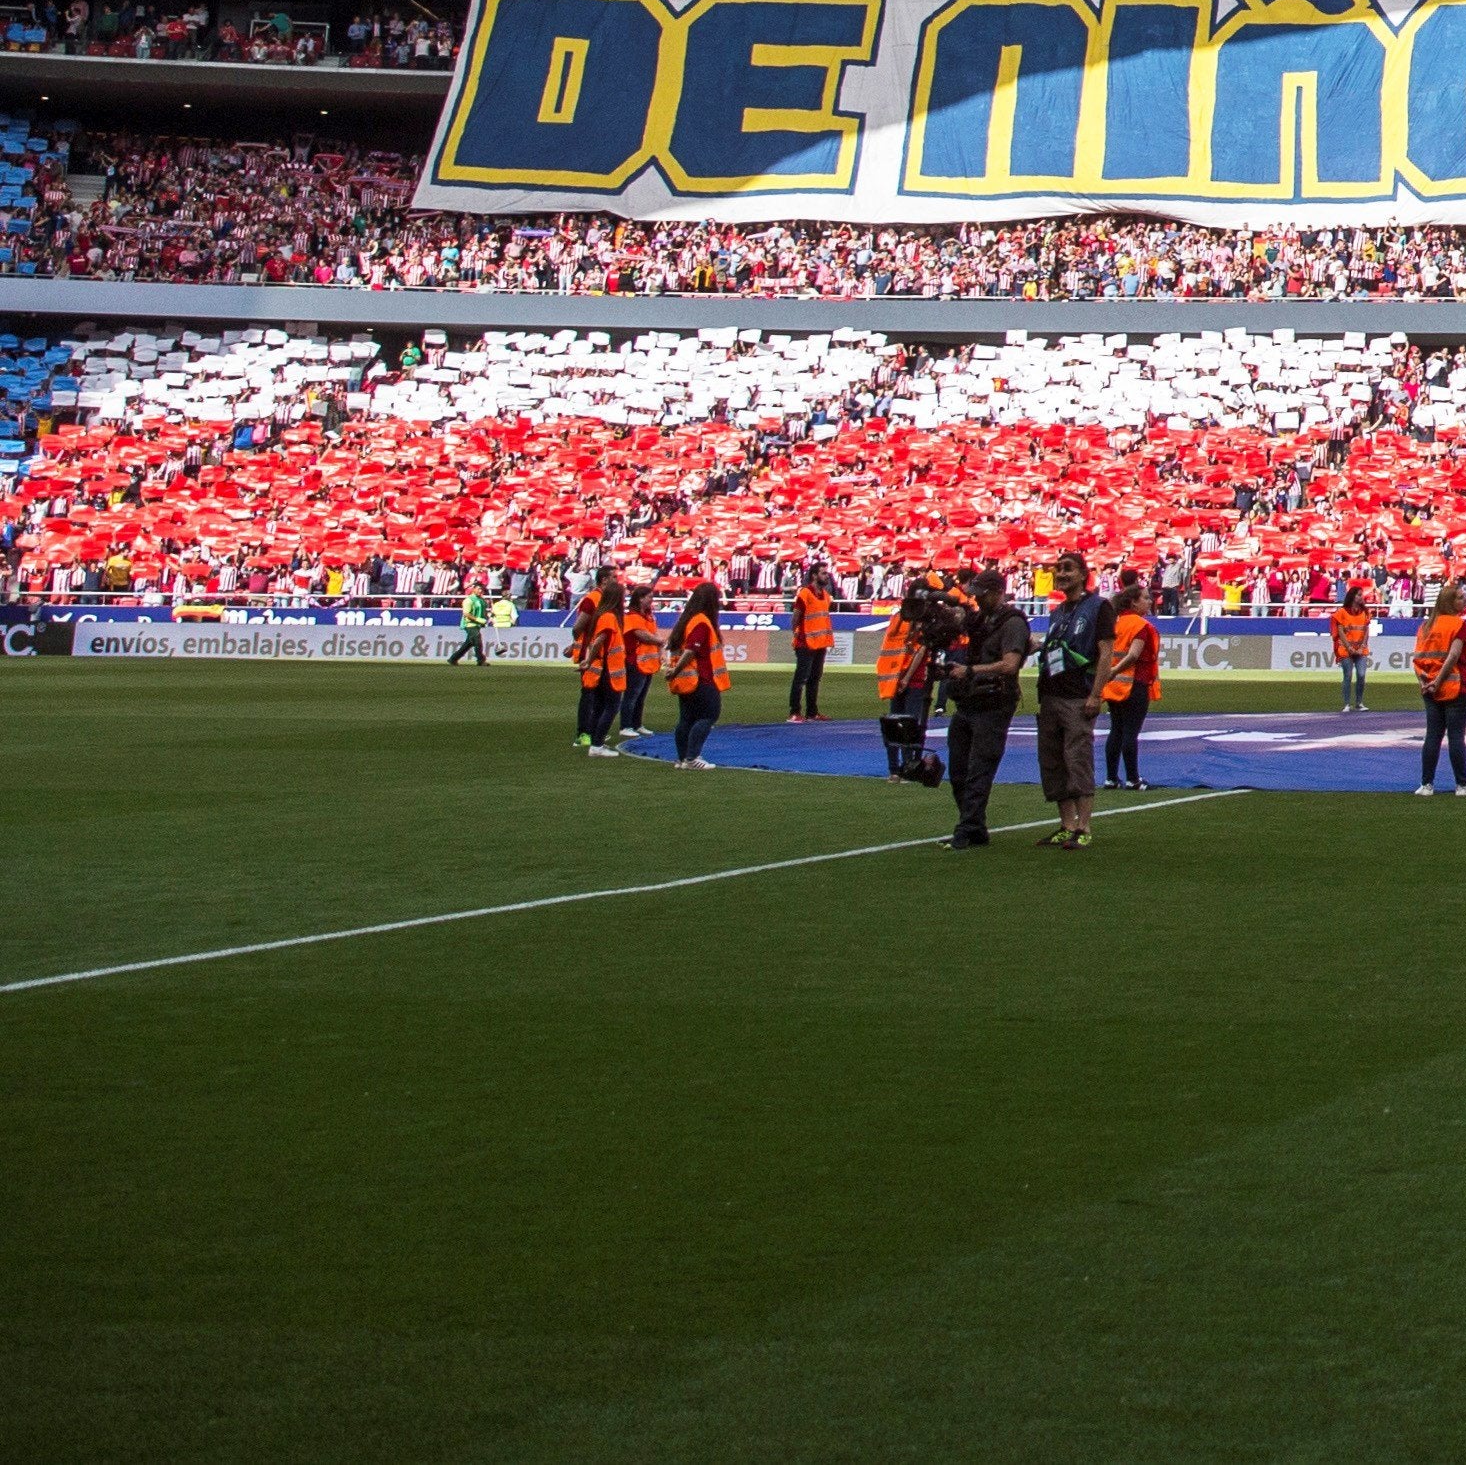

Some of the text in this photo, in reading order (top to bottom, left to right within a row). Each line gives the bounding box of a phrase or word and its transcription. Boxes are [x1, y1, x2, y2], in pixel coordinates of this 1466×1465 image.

[91, 631, 175, 657] envíos,
[183, 633, 314, 658] embalajes,
[321, 634, 403, 658] diseño
[410, 635, 430, 657] &
